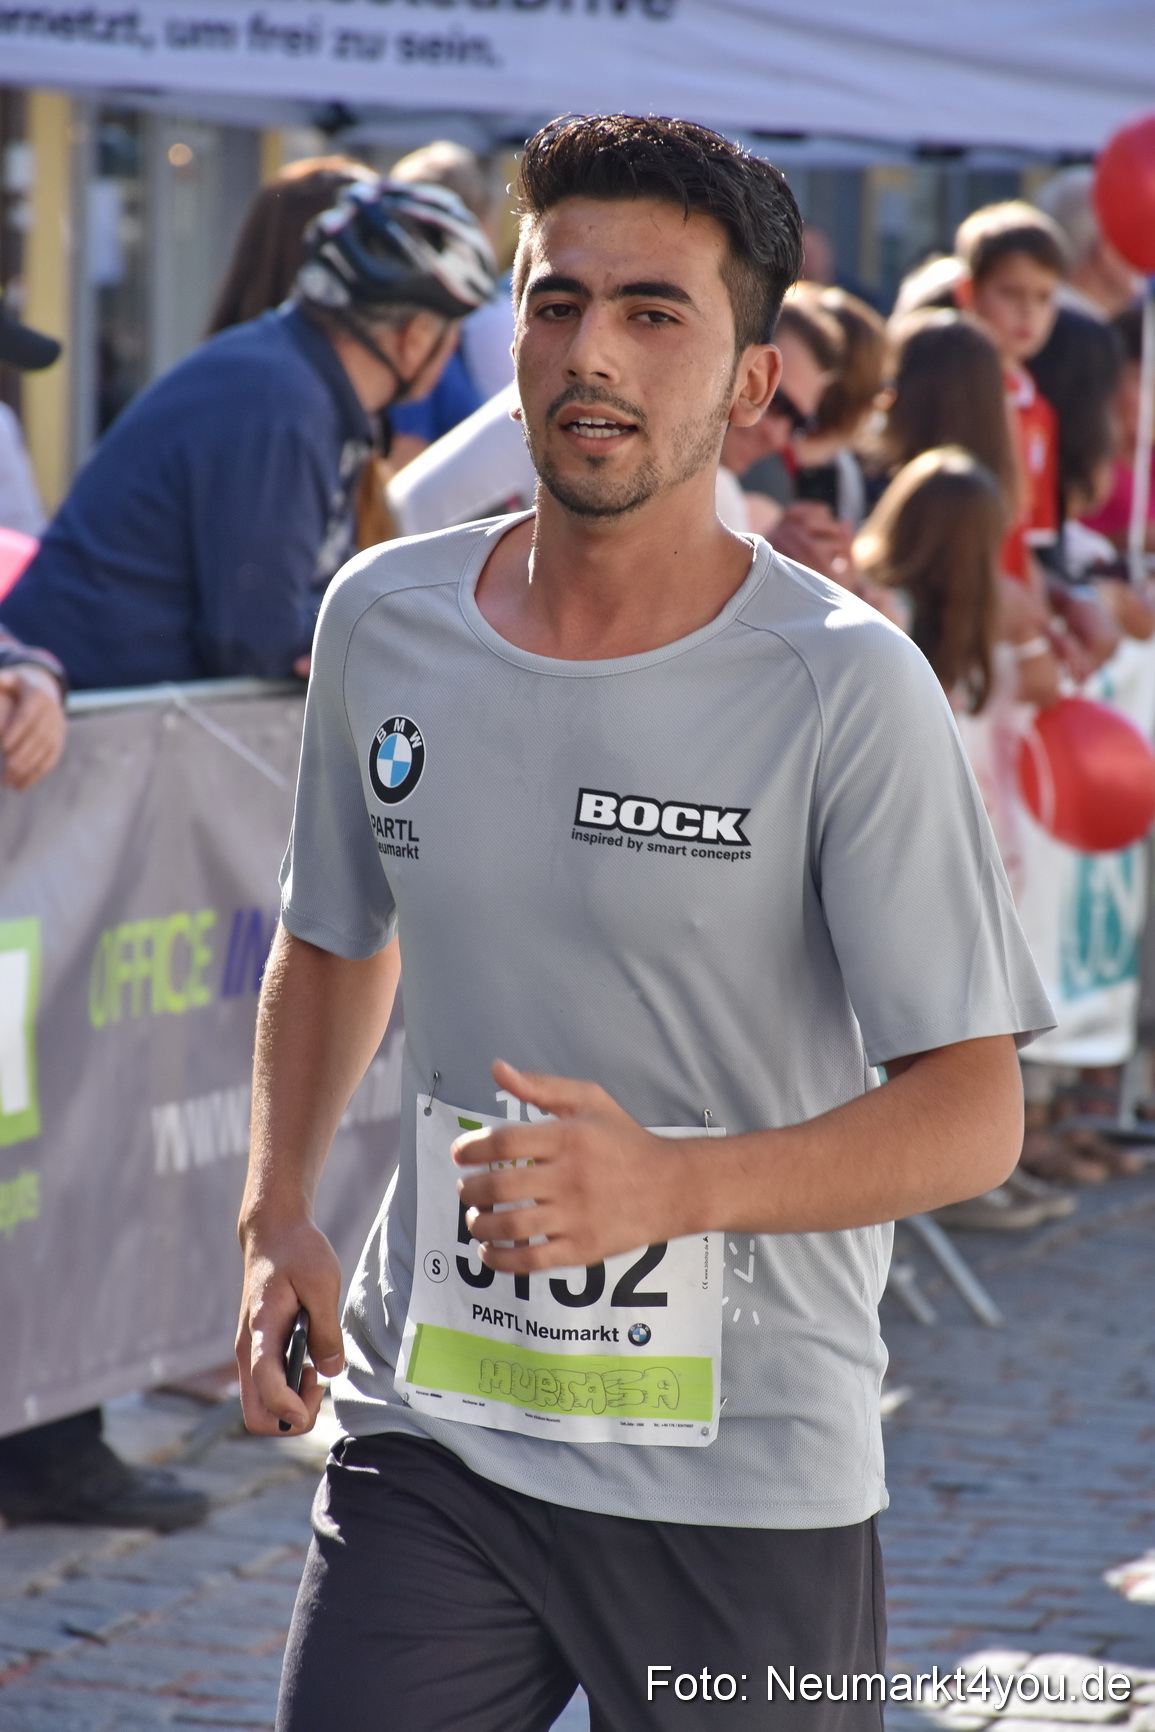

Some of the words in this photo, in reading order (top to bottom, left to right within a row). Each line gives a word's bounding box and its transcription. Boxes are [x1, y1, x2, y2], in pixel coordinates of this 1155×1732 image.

[165, 19, 238, 50] um
[249, 11, 320, 56] frei
[335, 26, 387, 61] zu
[397, 24, 502, 67] sein.
[375, 718, 423, 750] BMW
[371, 813, 420, 842] PARTL
[577, 790, 747, 844] BOCK
[376, 842, 420, 860] eumarkt
[571, 828, 623, 847] inspired
[627, 837, 643, 852] by
[647, 841, 687, 857] smart
[691, 847, 752, 862] concepts
[90, 909, 217, 1030] OFFICE
[431, 1258, 441, 1275] S
[472, 1303, 523, 1334] PARTL
[526, 1319, 619, 1343] Neumarkt
